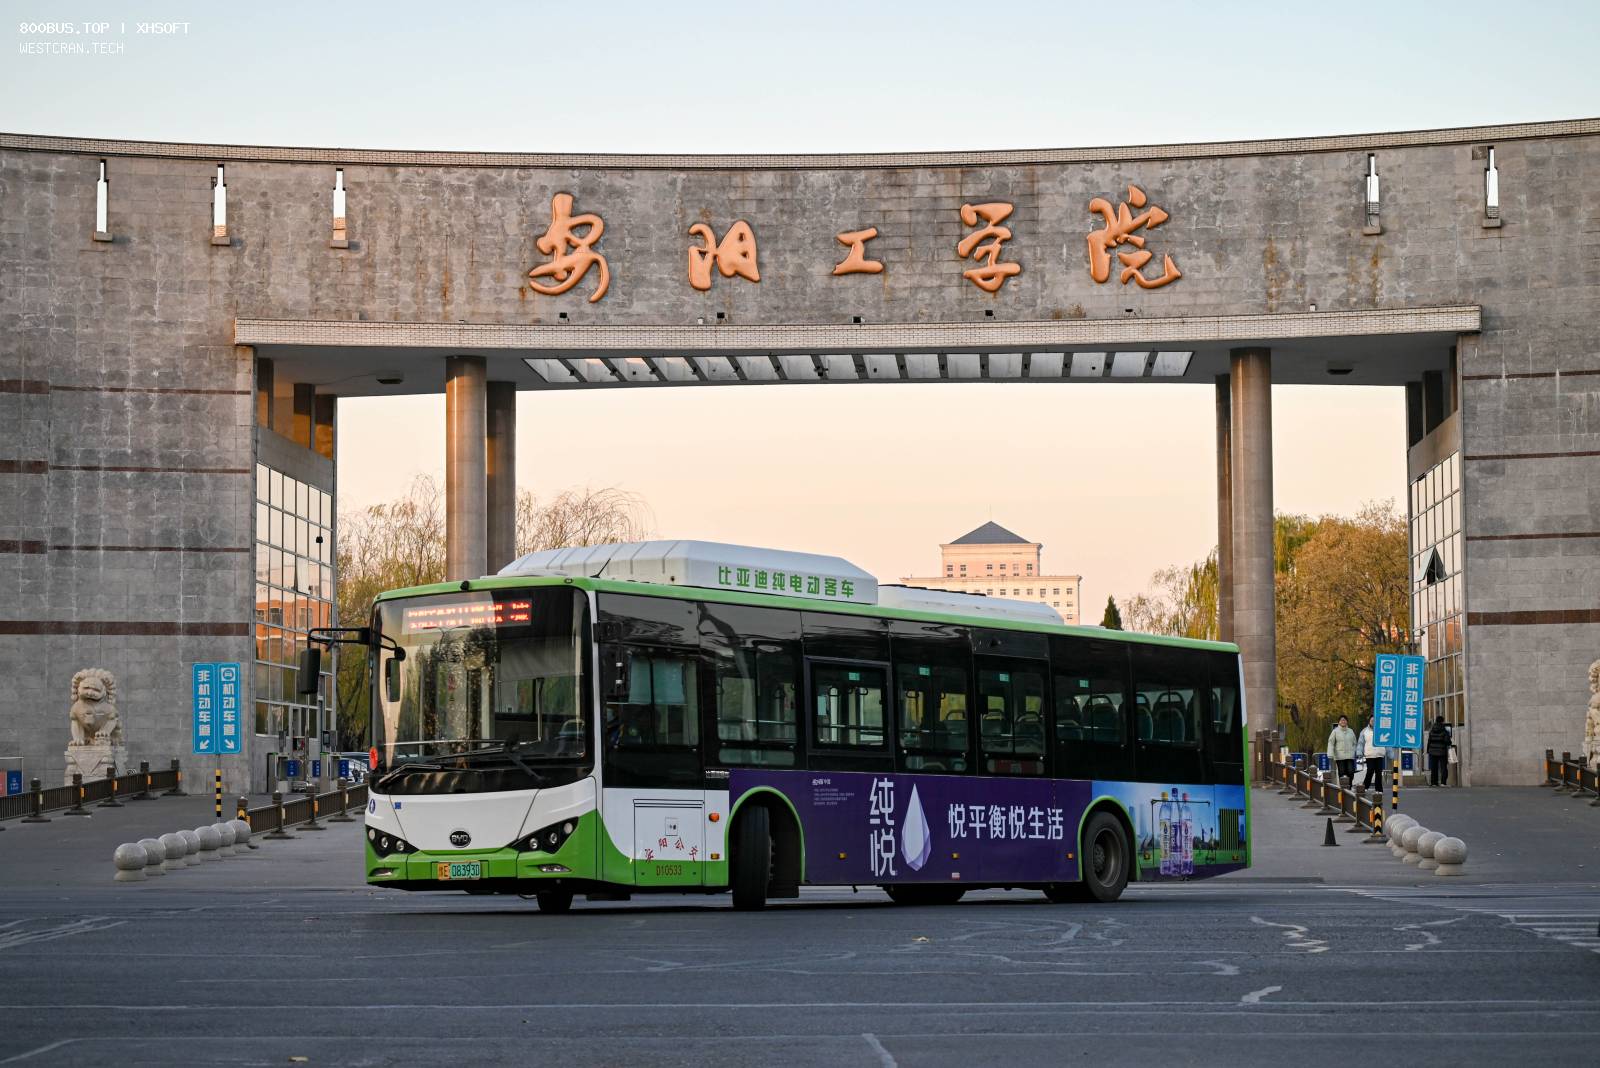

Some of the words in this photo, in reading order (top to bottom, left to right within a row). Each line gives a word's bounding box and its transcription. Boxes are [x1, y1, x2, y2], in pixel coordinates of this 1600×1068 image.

[529, 185, 1182, 302] 安阳工学院
[718, 565, 854, 598] 比亚迪纯电动客车
[451, 834, 470, 843] BYD
[869, 777, 896, 877] 纯悦
[948, 803, 1064, 840] 悦平衡悦生活
